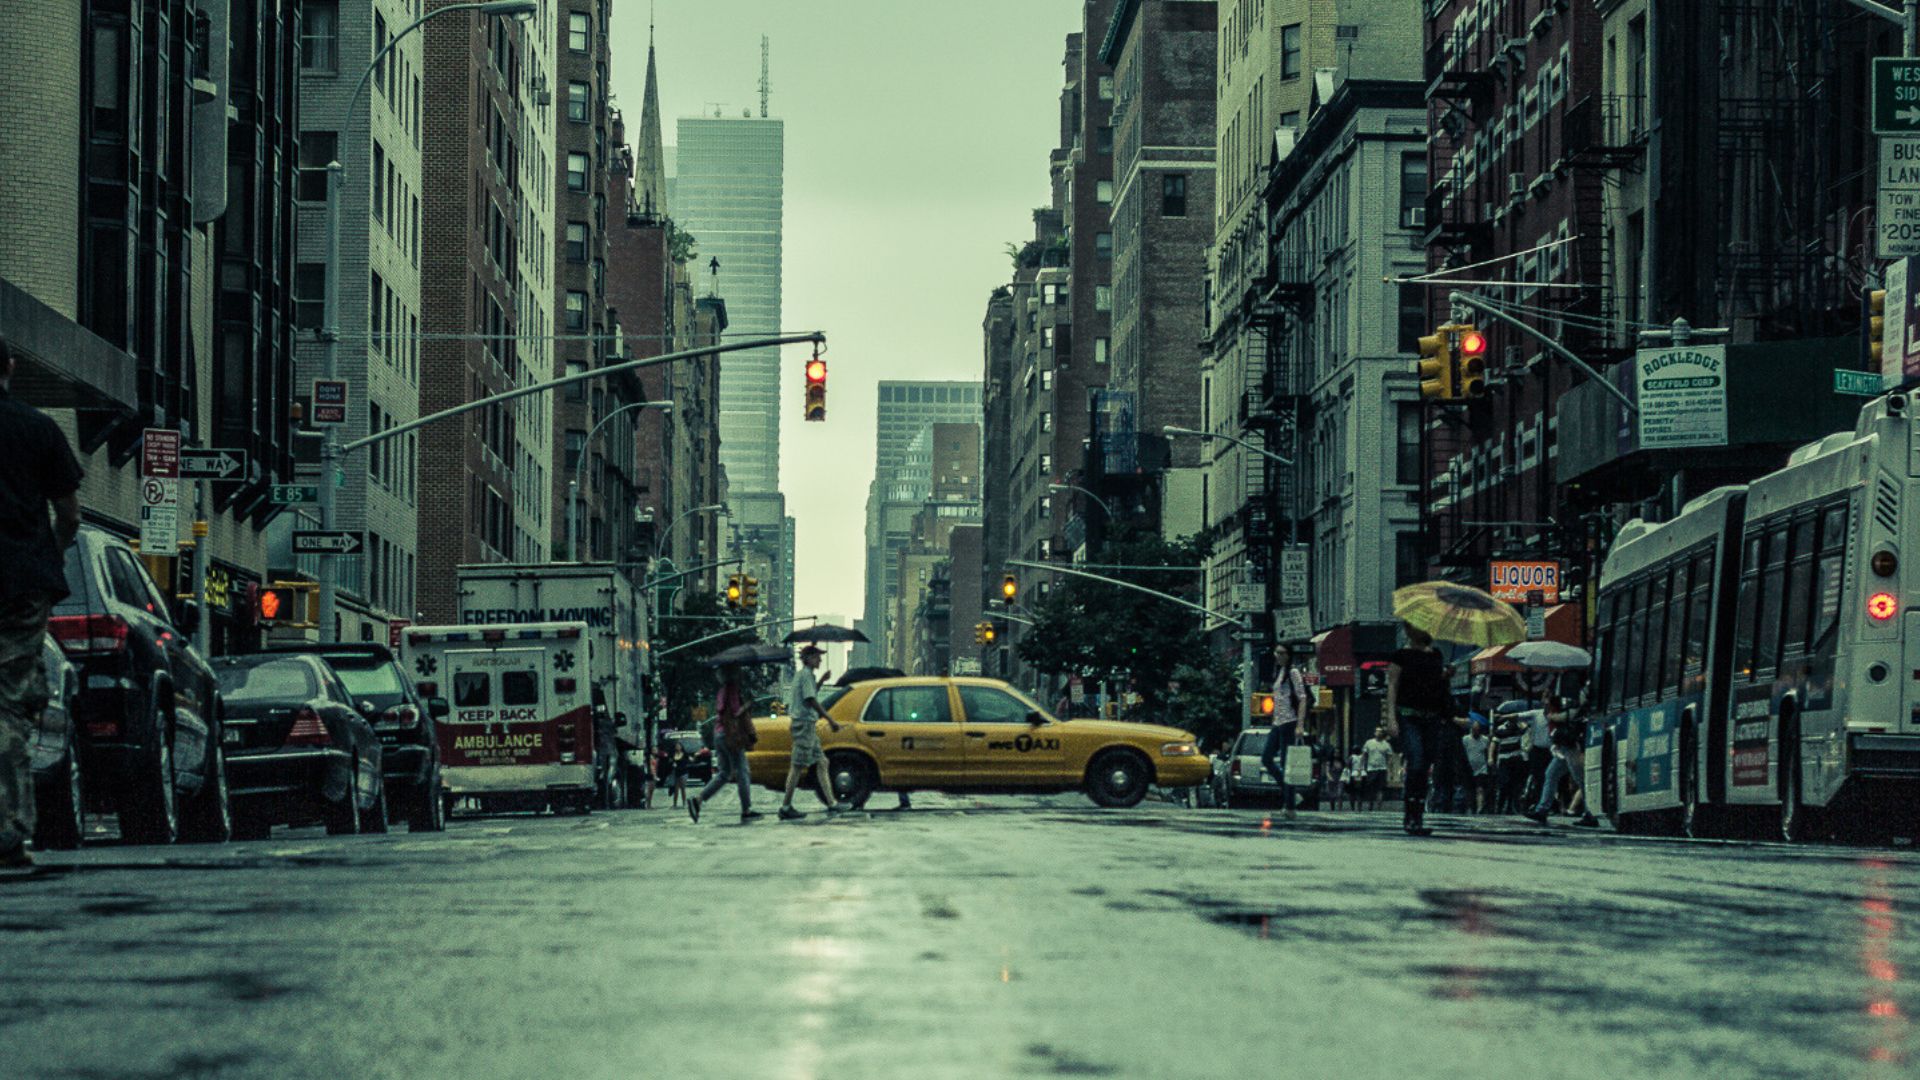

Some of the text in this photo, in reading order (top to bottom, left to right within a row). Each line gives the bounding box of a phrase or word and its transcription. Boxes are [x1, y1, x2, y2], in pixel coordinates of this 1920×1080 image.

[1893, 67, 1920, 81] WES
[1888, 167, 1920, 183] LAN
[1888, 194, 1912, 205] TOW
[1643, 352, 1720, 376] ROCKLEDGE
[1836, 373, 1882, 393] LEXINGTO
[181, 458, 232, 470] NE WAY
[273, 487, 281, 501] E
[287, 488, 303, 502] 85
[302, 539, 353, 548] ONE WAY
[1493, 566, 1555, 586] LIQUOR
[464, 606, 611, 628] FREEDOM MOVING
[458, 709, 537, 721] KEEP BACK
[454, 733, 544, 749] AMBULANCE
